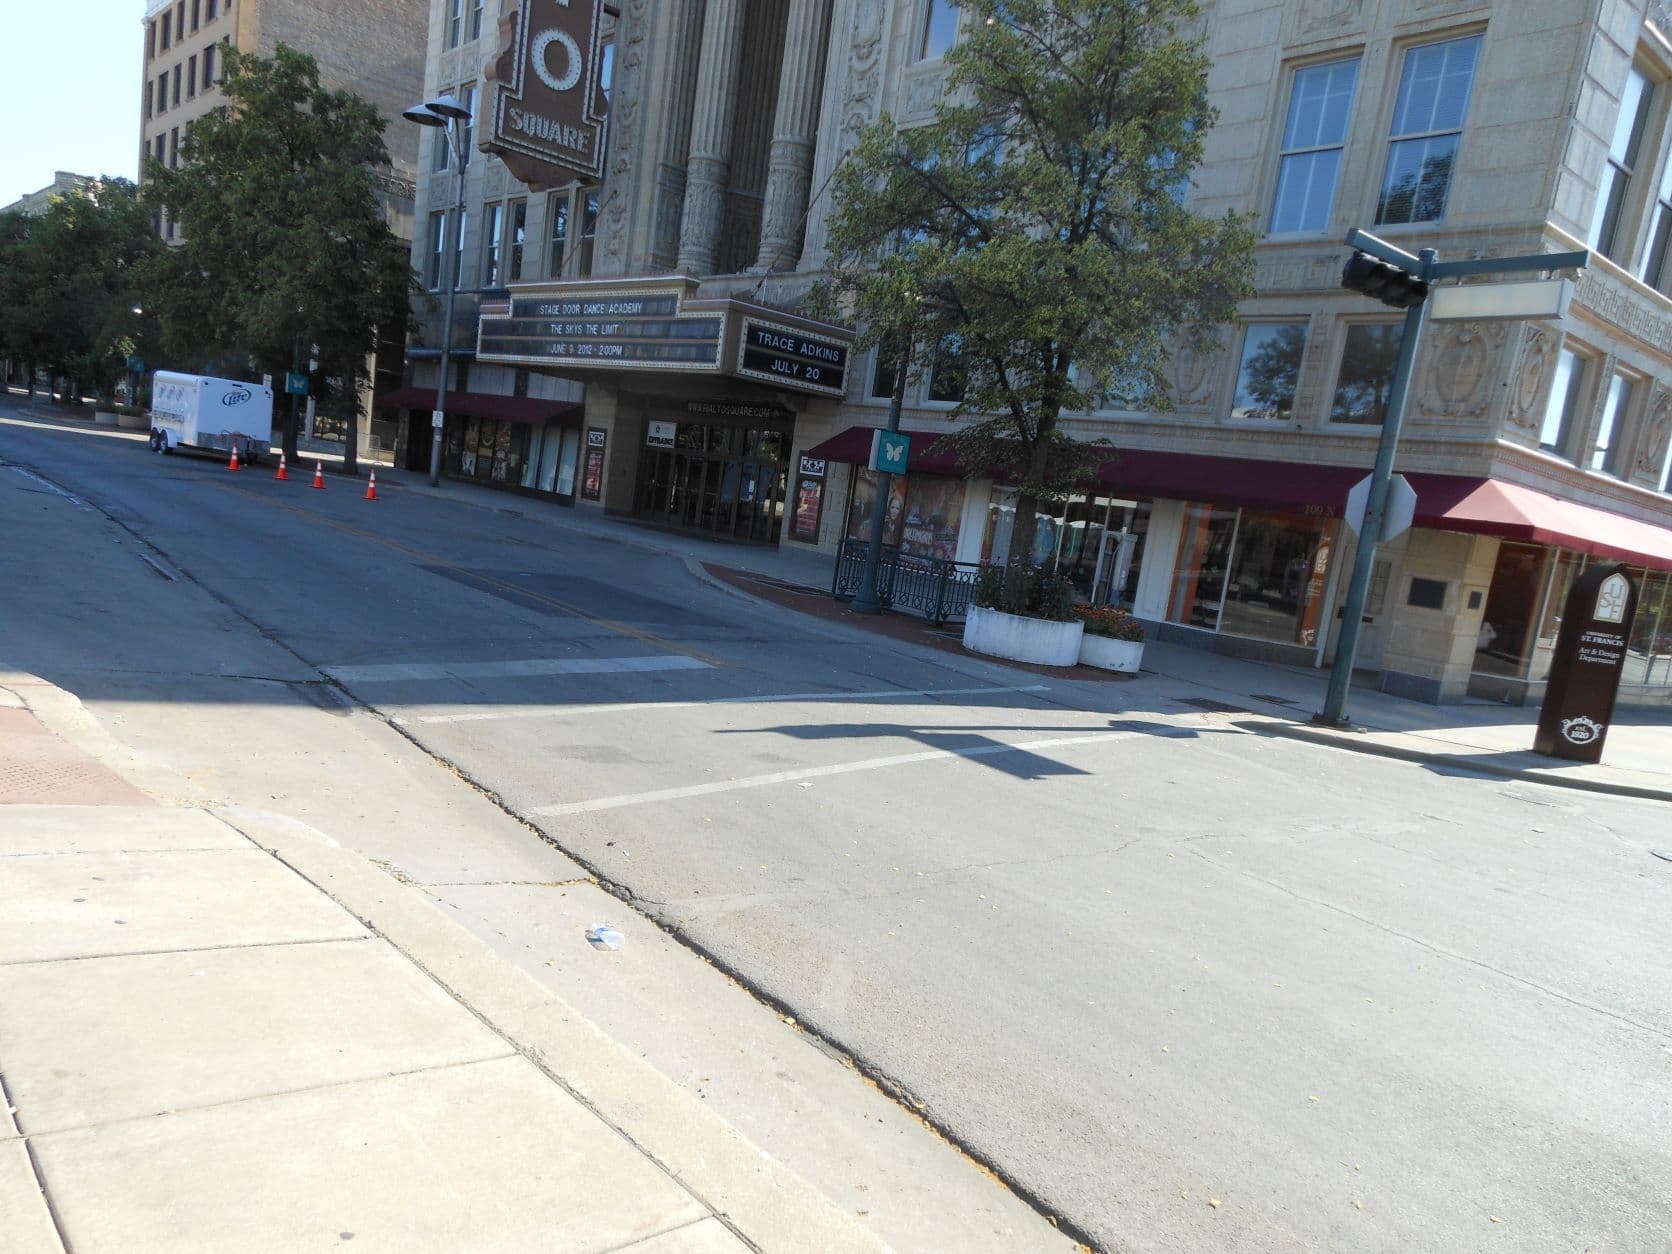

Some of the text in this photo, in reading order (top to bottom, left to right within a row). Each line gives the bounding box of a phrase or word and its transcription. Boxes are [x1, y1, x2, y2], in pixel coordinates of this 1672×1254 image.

[531, 0, 582, 91] O
[509, 107, 591, 153] SQUARE
[540, 302, 642, 315] STAGE DOOR DANCE ACADEMY
[551, 324, 562, 335] THE
[586, 324, 599, 335] THE
[601, 324, 619, 335] LIMIT
[551, 344, 566, 354] JUNE
[577, 344, 592, 354] 2012
[758, 331, 839, 361] TRACE ADKINS
[771, 359, 820, 380] JULY 20
[1304, 503, 1323, 515] 100
[1585, 630, 1614, 639] UNIVERSITY
[1592, 636, 1625, 647] FRANCIS
[1579, 646, 1621, 659] Art & Design
[1579, 653, 1617, 665] Department
